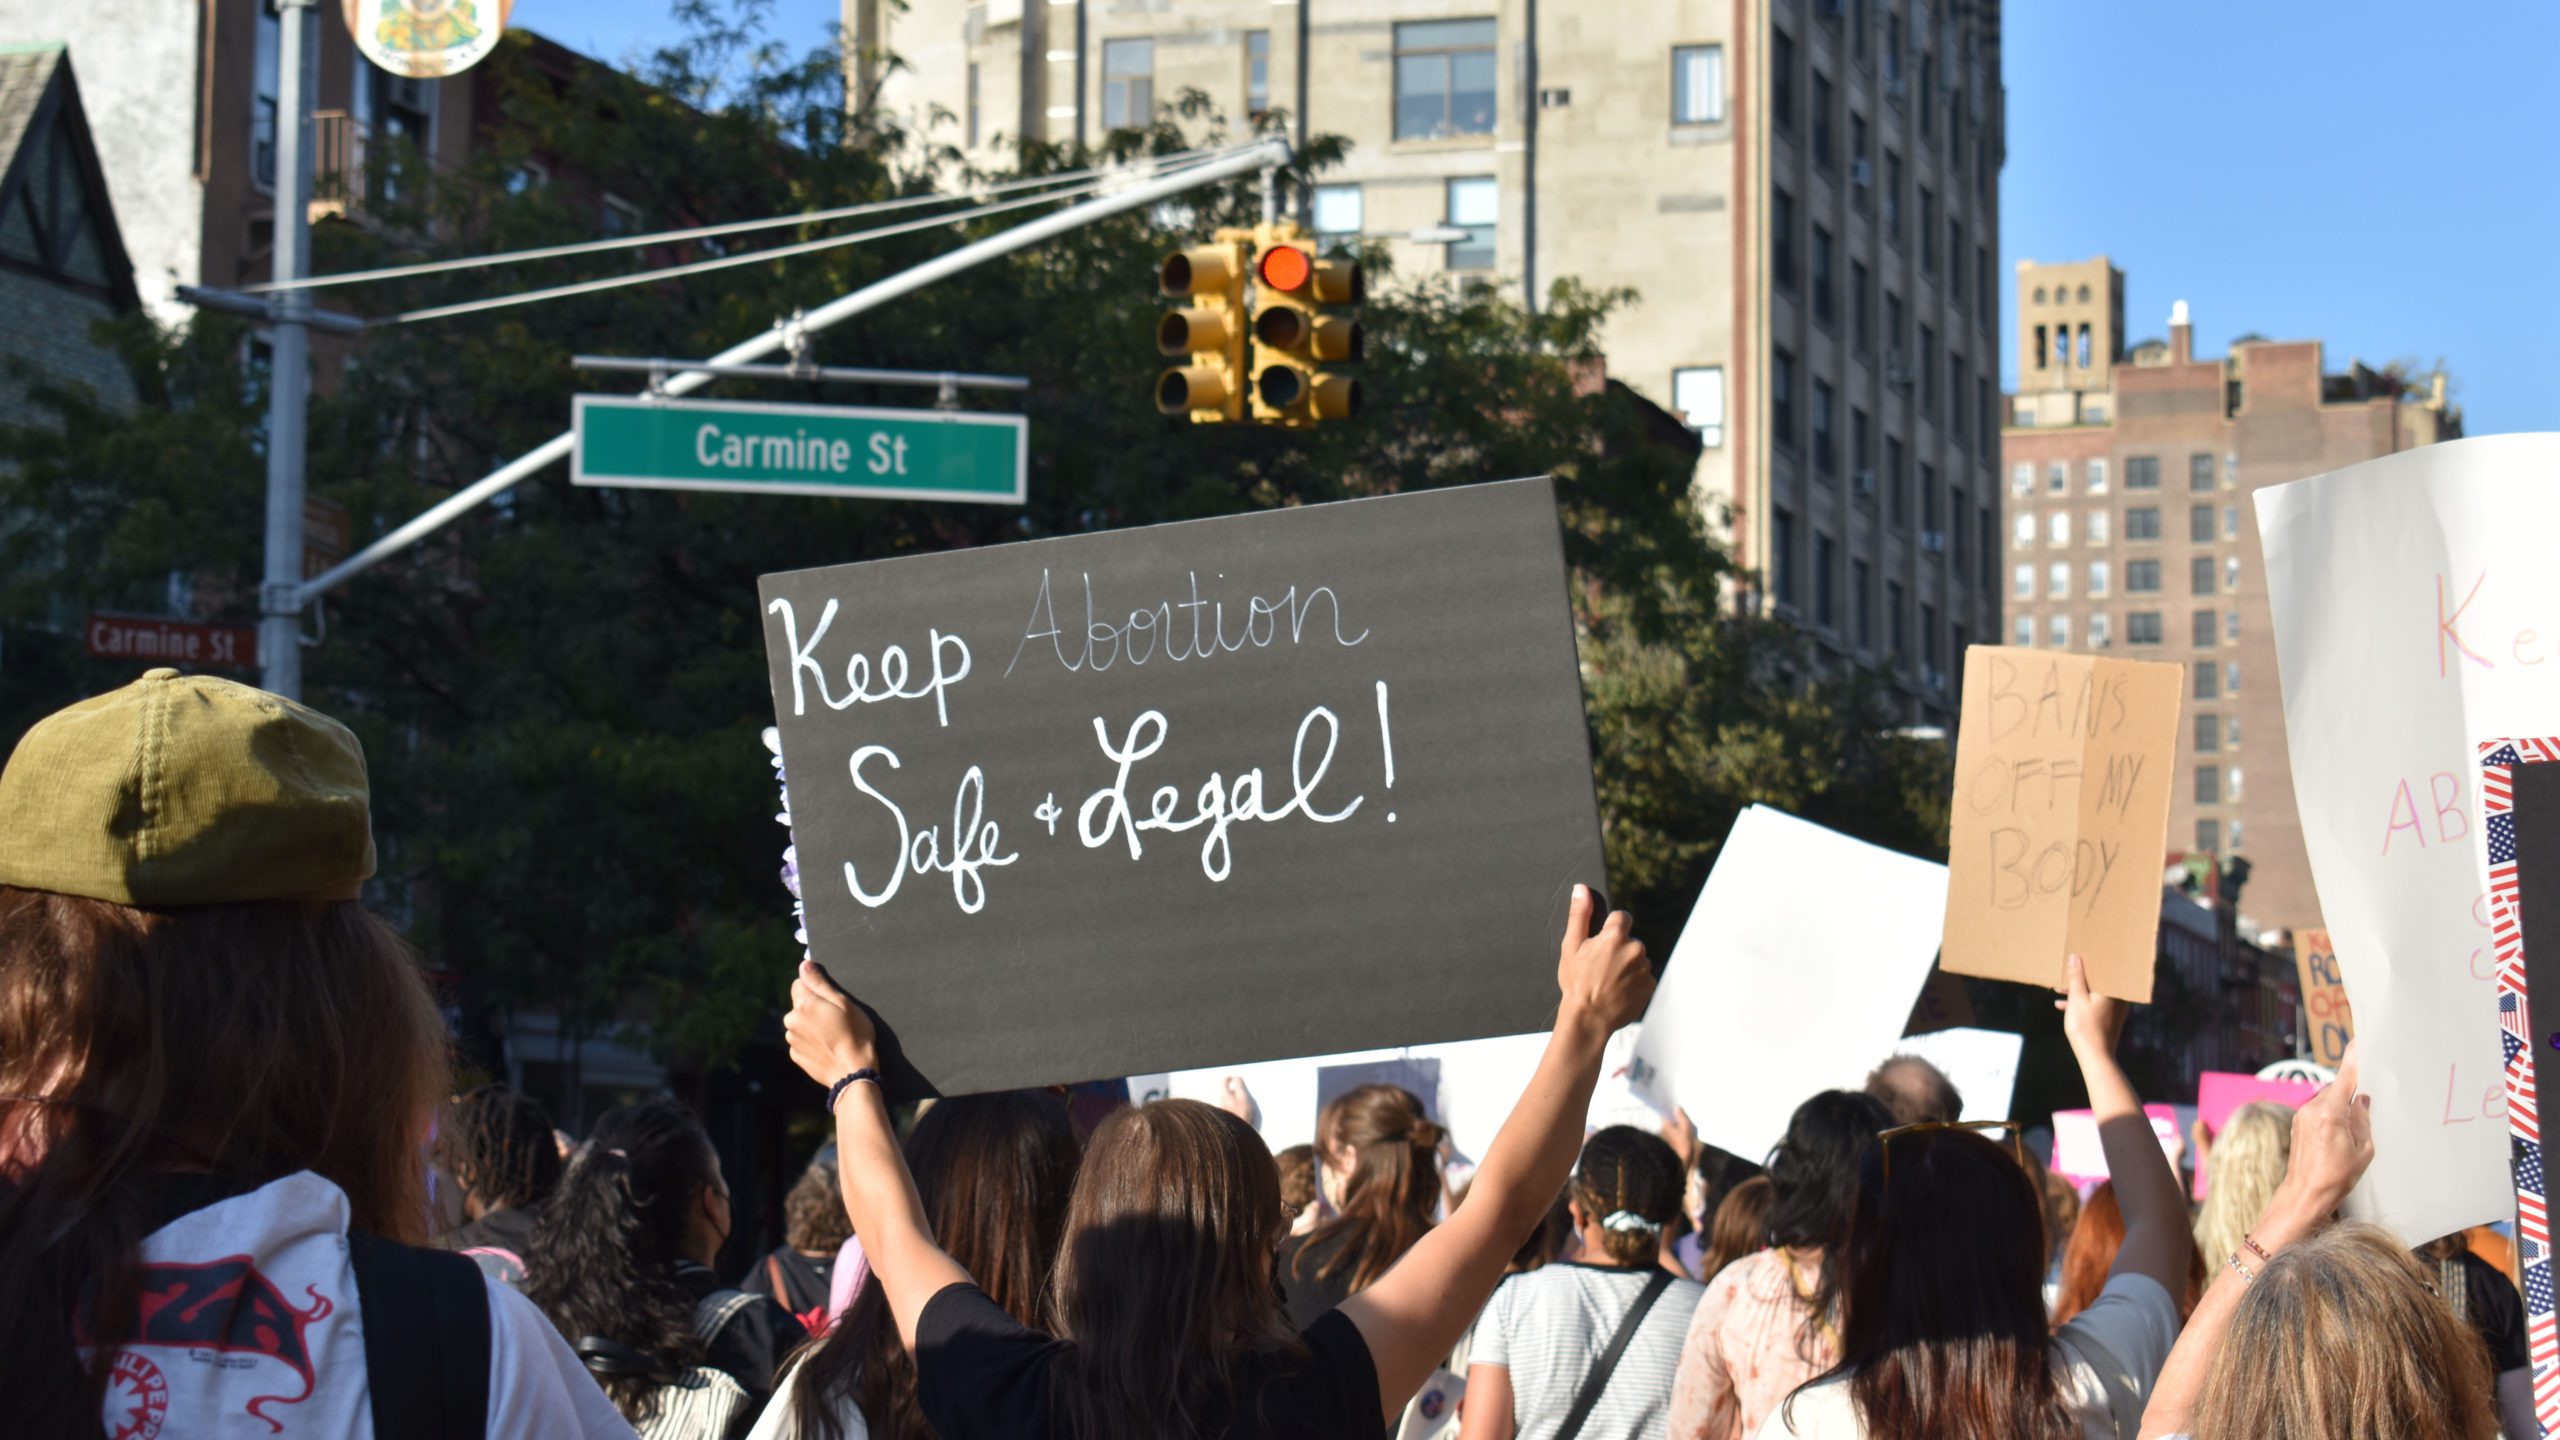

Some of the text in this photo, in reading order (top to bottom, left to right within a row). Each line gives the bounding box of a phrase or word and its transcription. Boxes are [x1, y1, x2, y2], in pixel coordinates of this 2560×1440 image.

[696, 423, 908, 475] Carmine St
[91, 621, 234, 662] Carmine St
[769, 568, 1369, 726] Keep Abortion
[2436, 567, 2560, 679] Ke
[1987, 655, 2128, 745] BANS
[843, 745, 1019, 913] Safe
[1078, 680, 1396, 882] Legal!
[1968, 753, 2146, 823] OFF MY
[2382, 769, 2490, 856] AB
[1989, 827, 2121, 918] BODY
[2309, 953, 2343, 987] RO
[2309, 985, 2351, 1027] OF
[2442, 1063, 2509, 1125] Le
[112, 1353, 152, 1377] ILI
